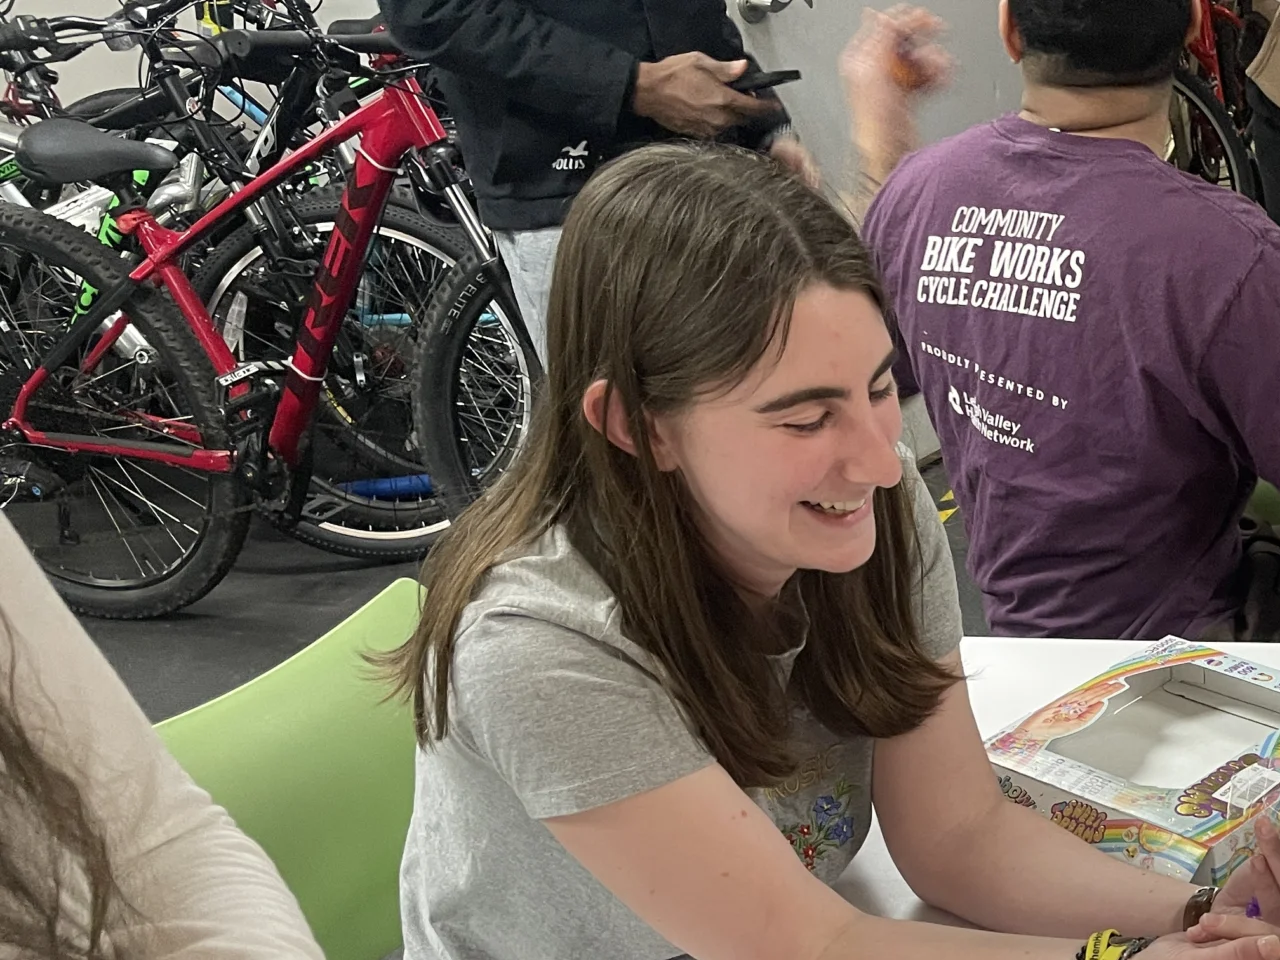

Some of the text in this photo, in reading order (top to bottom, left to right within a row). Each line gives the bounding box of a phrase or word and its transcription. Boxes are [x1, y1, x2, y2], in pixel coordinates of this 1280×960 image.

[951, 206, 1065, 241] COMMUNITY
[284, 158, 377, 398] TREK
[920, 235, 1085, 288] BIKE WORKS
[447, 283, 477, 319] ELITE
[916, 275, 1081, 322] CYCLE CHALLENGE
[1052, 395, 1068, 410] BY
[980, 422, 1035, 453] Network
[981, 408, 1021, 435] Valley
[1063, 799, 1108, 828] SWEET
